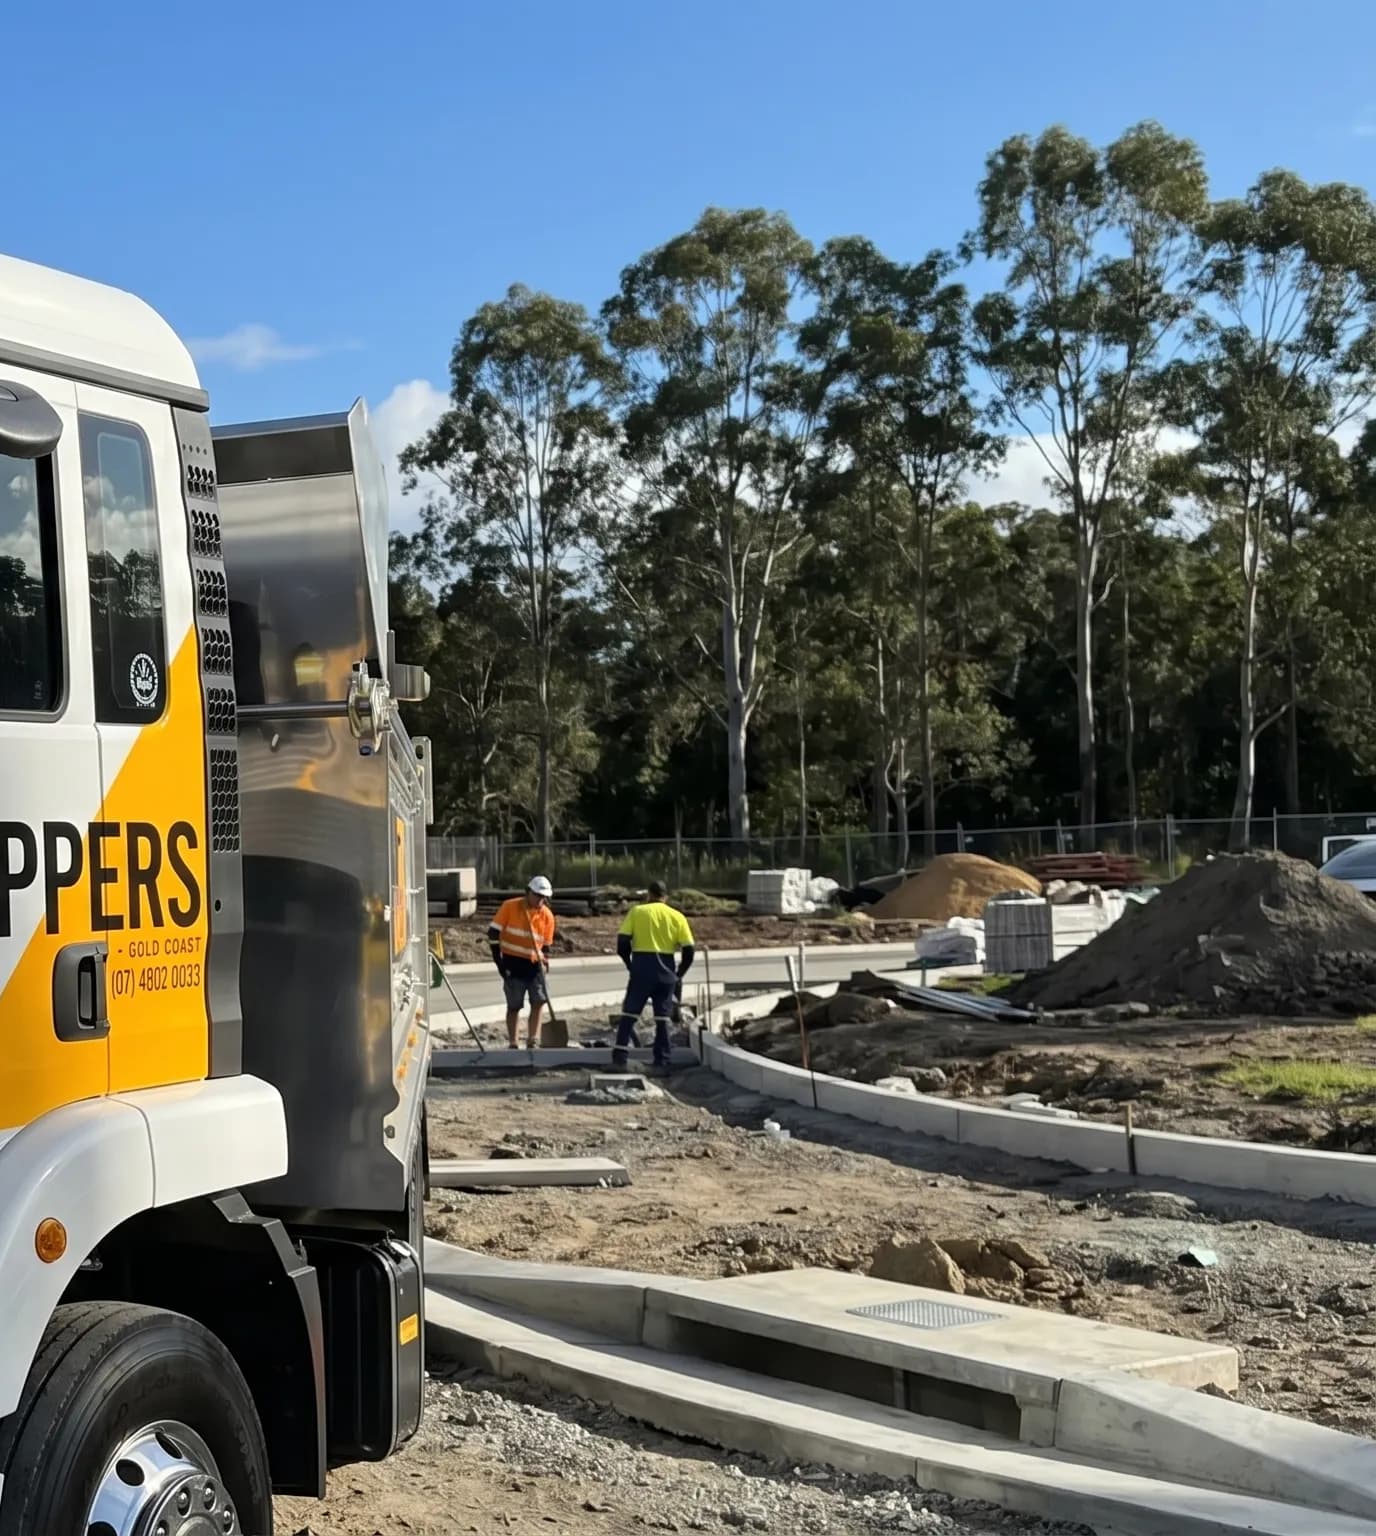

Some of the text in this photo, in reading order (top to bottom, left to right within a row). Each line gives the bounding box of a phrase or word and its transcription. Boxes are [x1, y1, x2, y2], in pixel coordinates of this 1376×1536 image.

[129, 940, 159, 958] GOLD
[165, 937, 201, 955] COAST
[112, 963, 201, 1000] (07) 4802 0033
